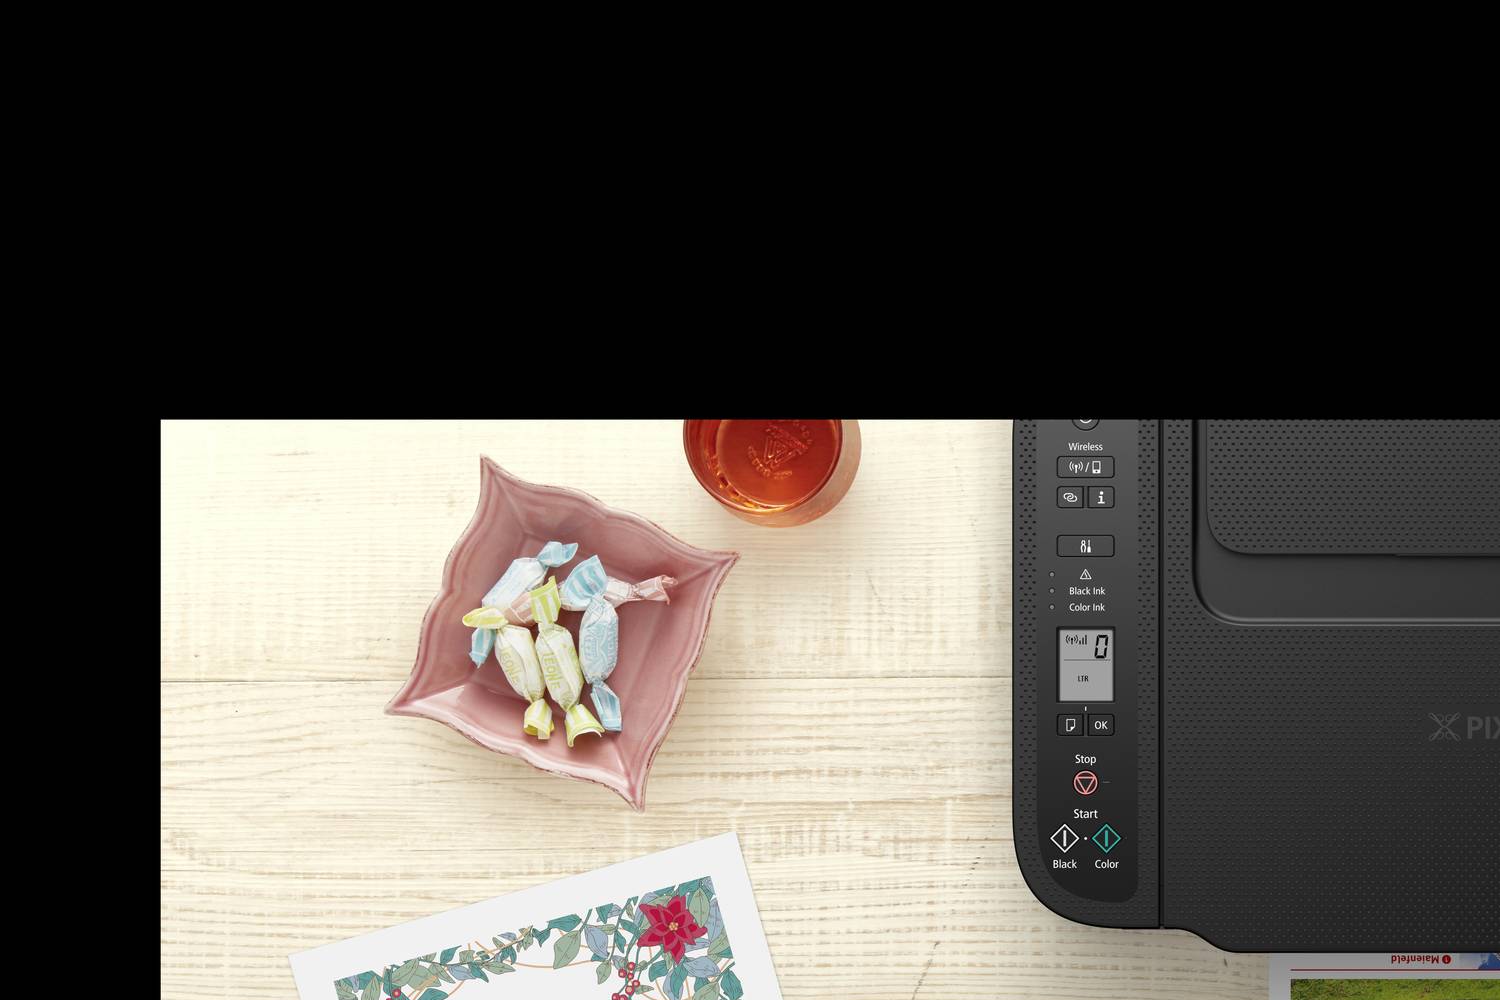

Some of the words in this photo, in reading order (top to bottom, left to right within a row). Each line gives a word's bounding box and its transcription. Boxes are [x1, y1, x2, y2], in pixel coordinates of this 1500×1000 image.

[1068, 443, 1103, 451] Wireless
[1069, 587, 1091, 595] Black
[1093, 587, 1106, 595] Ink
[1069, 603, 1091, 612] Color
[1093, 603, 1106, 612] Ink
[1094, 634, 1109, 659] 0
[1077, 674, 1089, 682] LTR
[1094, 720, 1108, 730] OK
[1075, 754, 1097, 766] Stop
[1073, 809, 1099, 819] Start
[1053, 859, 1078, 869] Black
[1094, 859, 1119, 869] Color
[1391, 954, 1440, 965] Maienfeld
